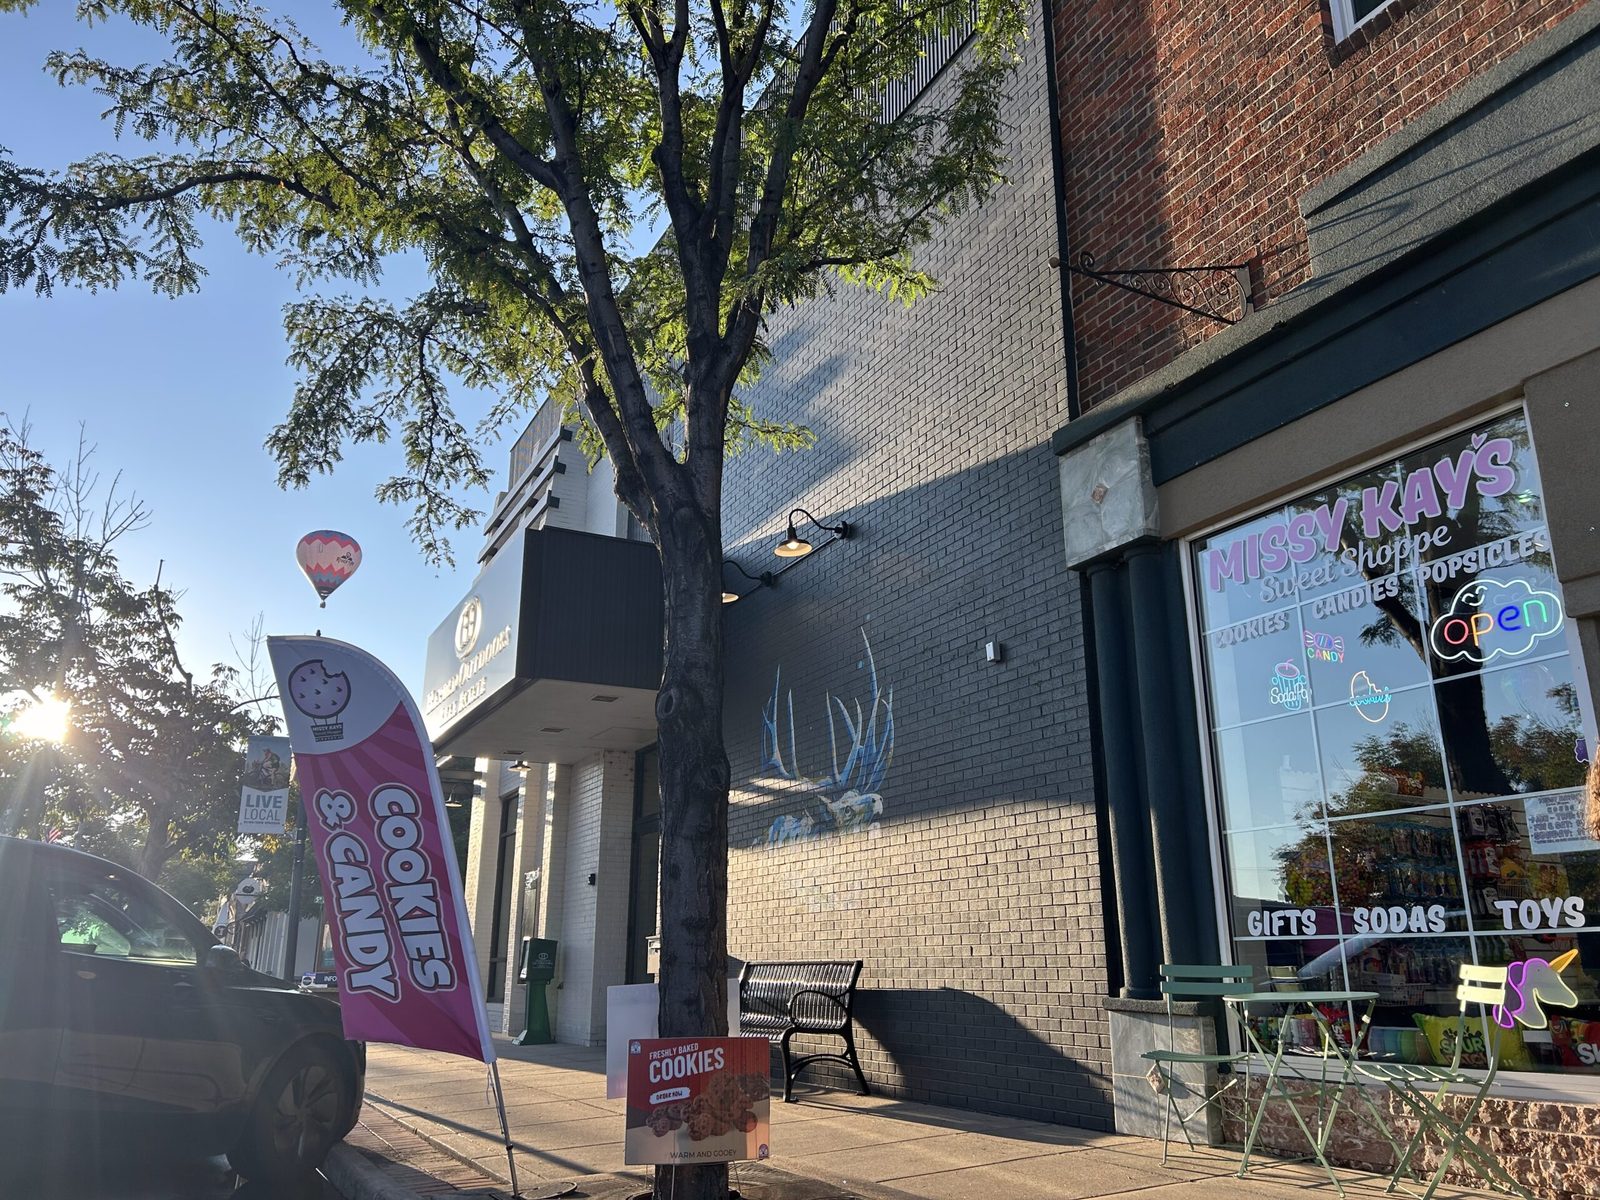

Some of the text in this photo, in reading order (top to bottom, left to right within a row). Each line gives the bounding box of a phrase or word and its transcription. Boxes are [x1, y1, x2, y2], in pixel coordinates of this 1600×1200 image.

[1208, 498, 1348, 594] MISSY
[1258, 524, 1453, 603] Sweet Shoppe
[1215, 530, 1550, 648] COOKIES CANDIES POPSICLES
[1307, 648, 1344, 663] CANDY
[244, 807, 281, 821] LOCAL
[245, 794, 283, 809] LIVE
[317, 791, 352, 830] &
[371, 787, 454, 990] COOKIES
[327, 833, 398, 999] CANDY
[1247, 896, 1586, 936] GIFTS SODAS TOYS
[649, 1043, 699, 1060] FRESHLY BAKED
[649, 1047, 725, 1084] COOKIES
[670, 1149, 737, 1159] WARM AND GOOEY
